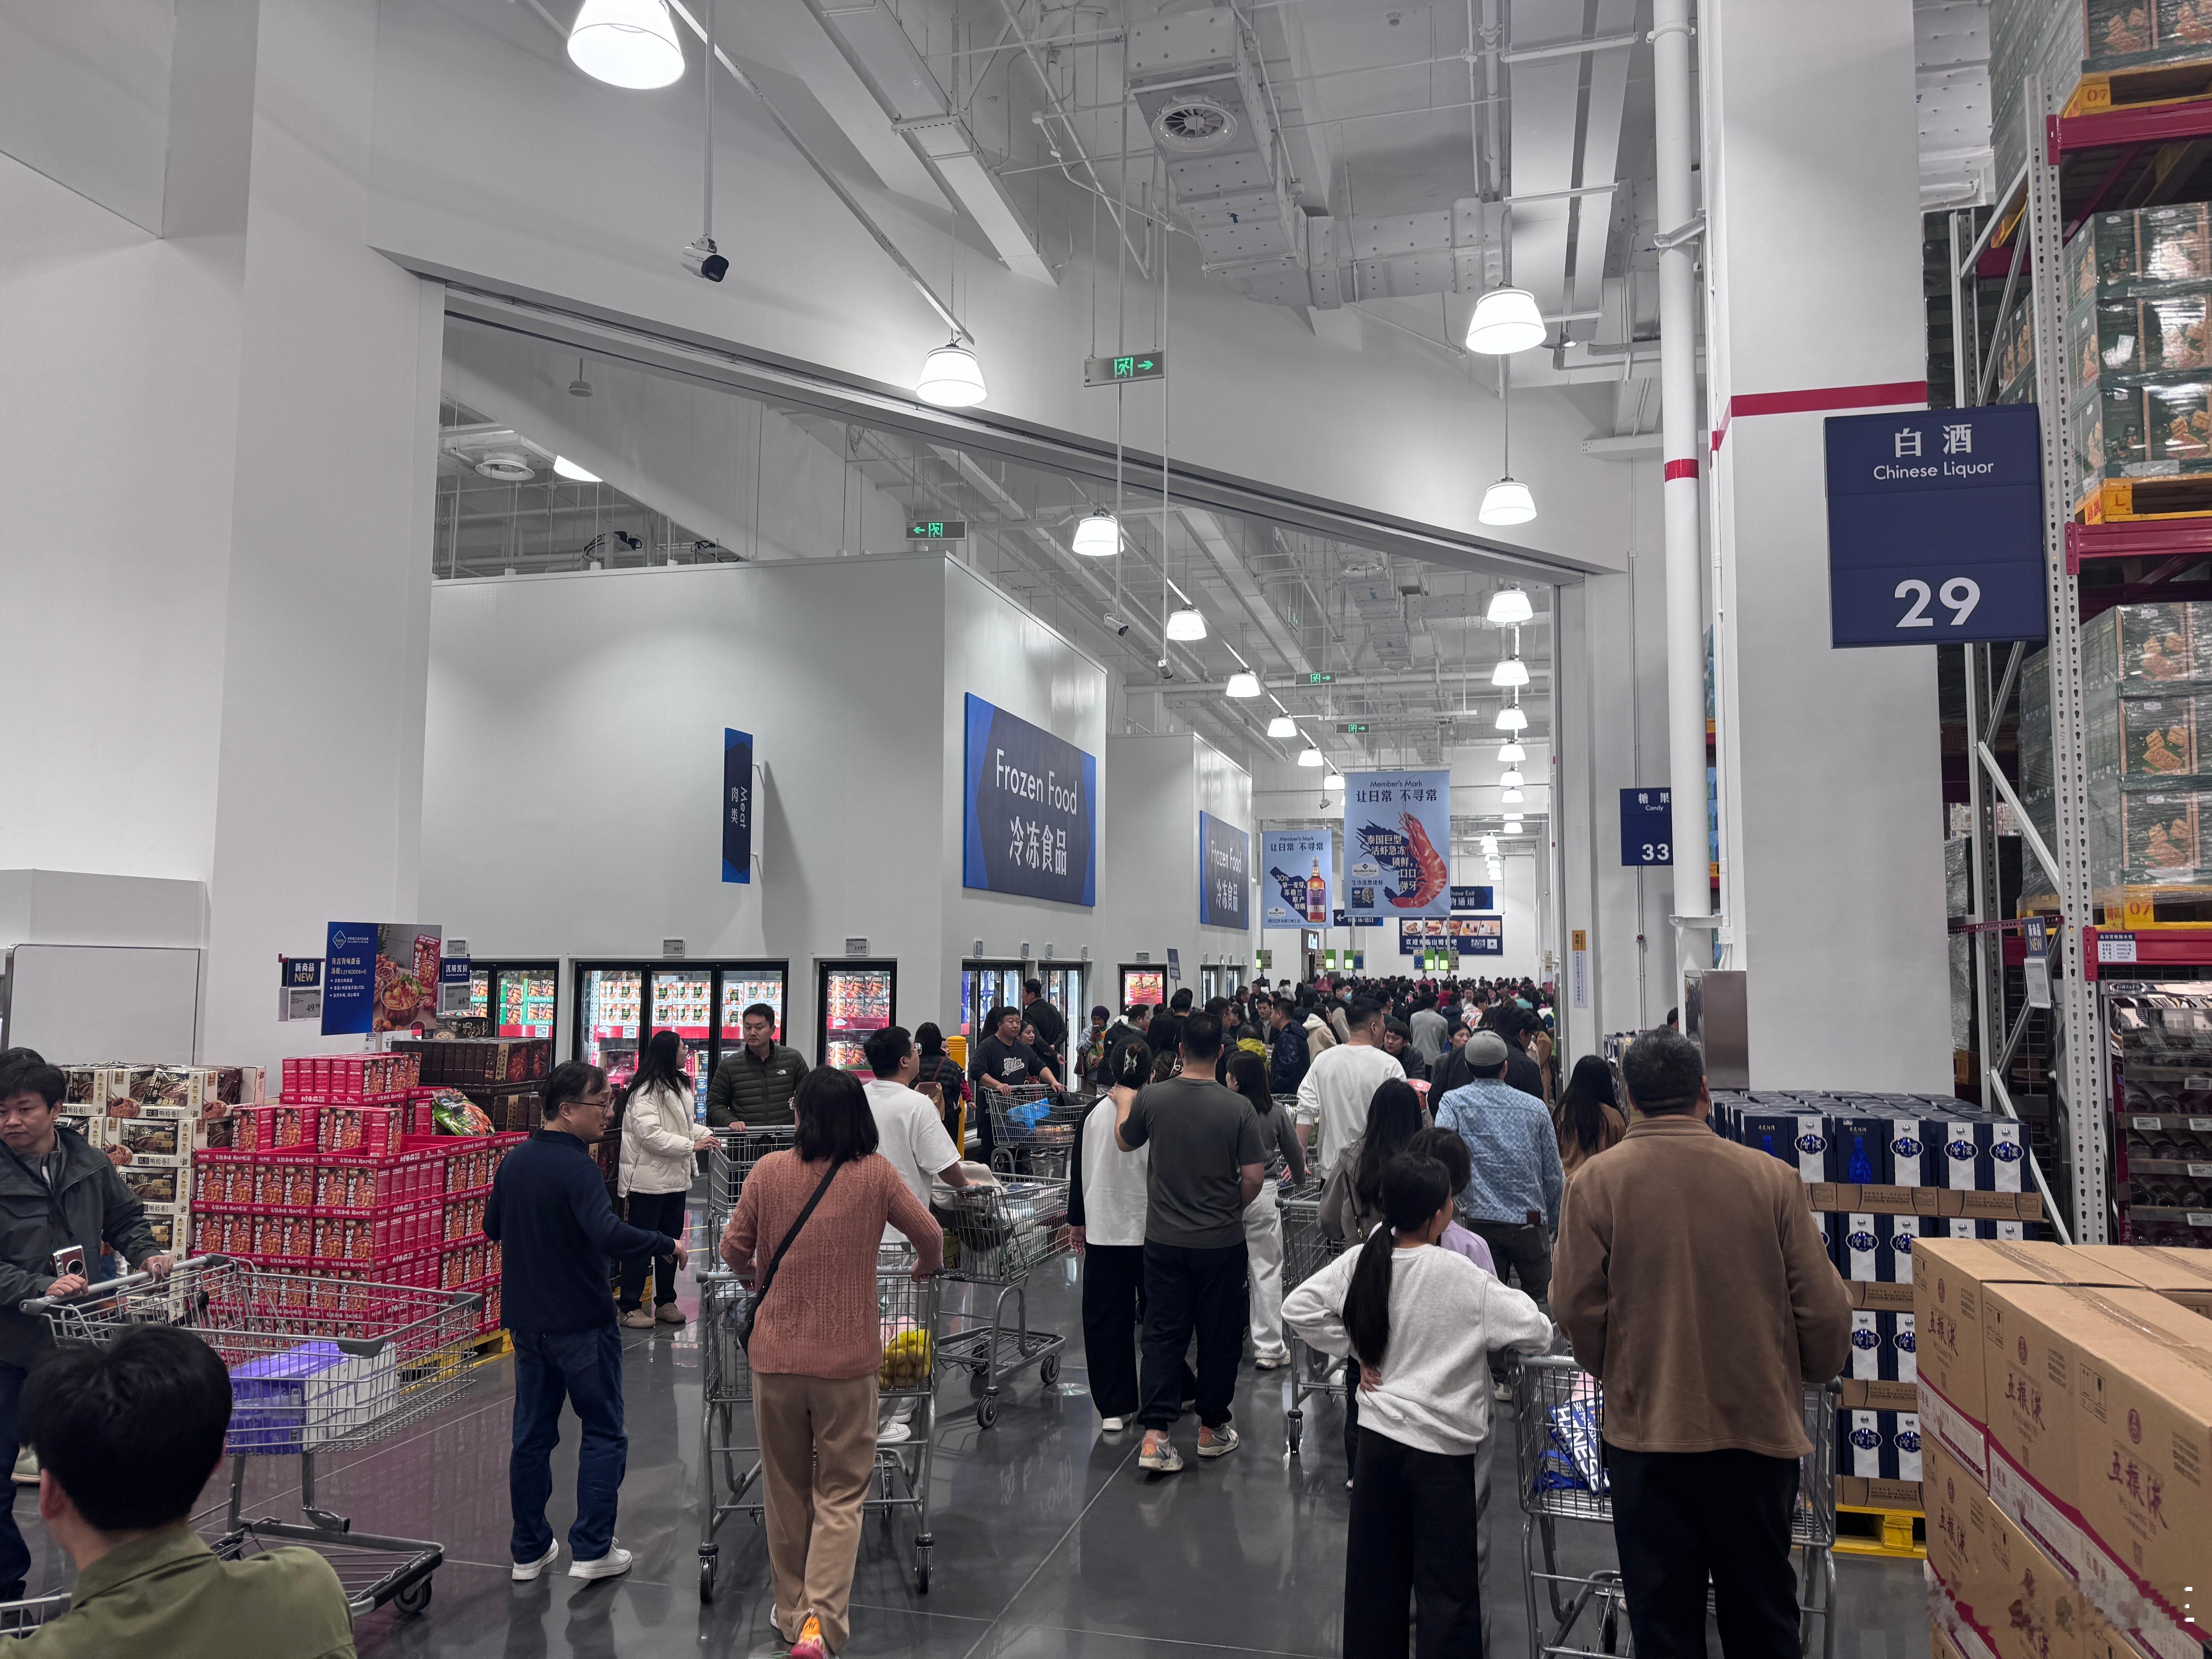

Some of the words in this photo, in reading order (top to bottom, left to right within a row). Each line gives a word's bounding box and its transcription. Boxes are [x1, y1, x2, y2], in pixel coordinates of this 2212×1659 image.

[2087, 89, 2107, 101] 07
[1895, 424, 1972, 458] 白酒
[1874, 465, 1937, 480] Chinese
[1944, 462, 1994, 478] Liquor
[1894, 577, 1980, 628] 29
[996, 749, 1044, 804] Frozen
[1048, 771, 1077, 815] Food
[1356, 790, 1392, 802] 让日常
[1400, 788, 1437, 802] 不寻常
[1638, 792, 1669, 804] 糖果
[731, 787, 738, 824] 肉类
[740, 786, 748, 829] Meat
[1009, 816, 1067, 876] 冷冻食品
[1367, 835, 1402, 845] 泰国巨型
[1271, 843, 1294, 852] 让日常
[1299, 842, 1323, 851] 不寻常
[1371, 846, 1406, 856] 活虾急冻
[1642, 843, 1669, 861] 33
[1211, 840, 1228, 869] Frozen
[1230, 848, 1242, 873] Food
[1400, 869, 1417, 878] 口口
[1400, 881, 1417, 891] 弹牙
[1216, 878, 1238, 912] 冷冻食品
[2130, 902, 2150, 915] 07
[2028, 923, 2041, 937] 新商品
[2030, 938, 2042, 951] NEW
[295, 963, 314, 972] 新商品
[446, 964, 467, 973] 优质优价
[294, 972, 314, 982] NEW
